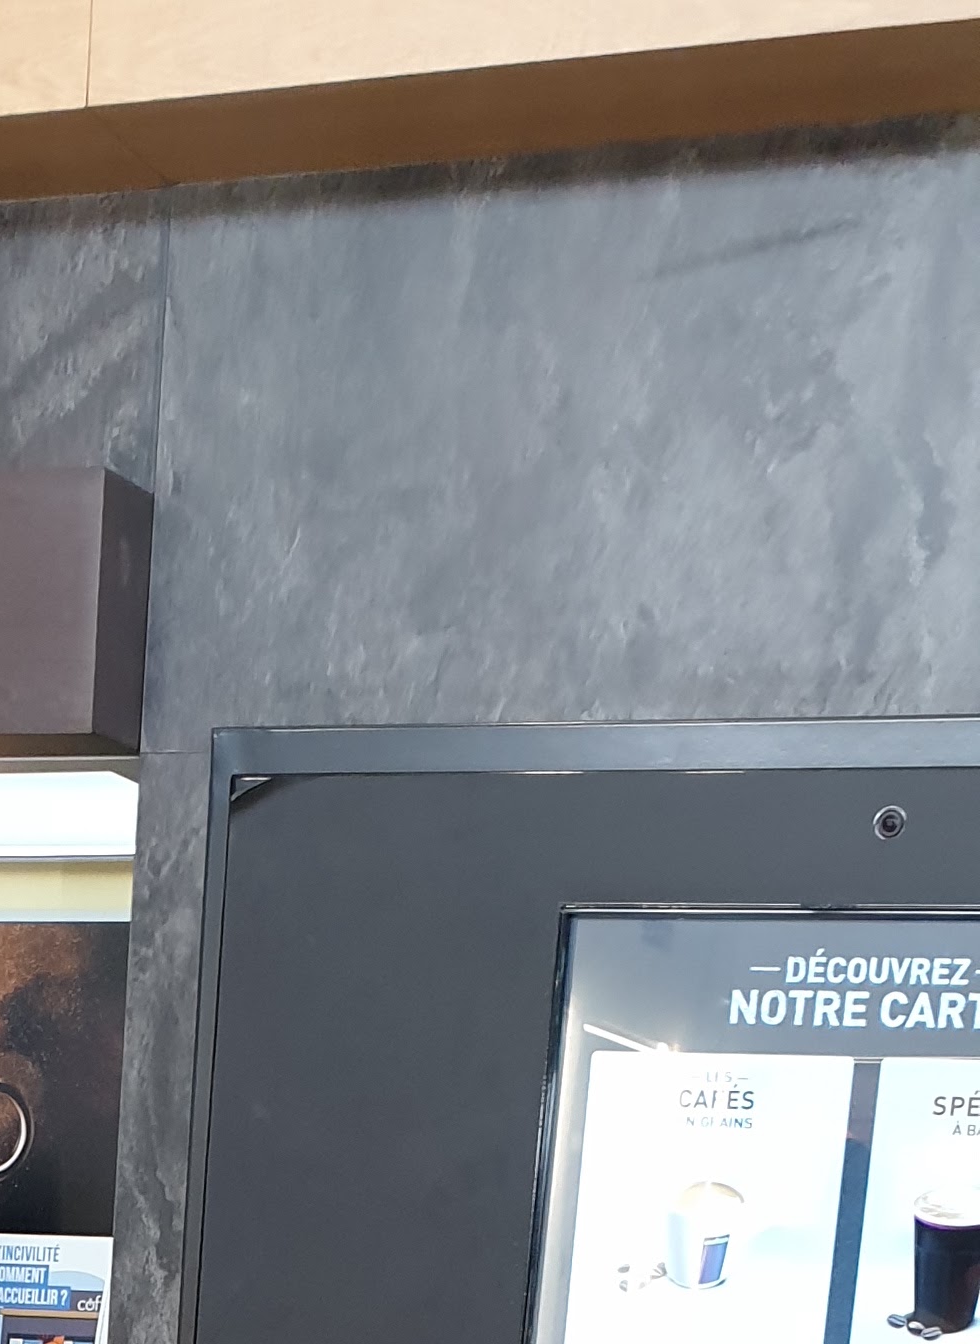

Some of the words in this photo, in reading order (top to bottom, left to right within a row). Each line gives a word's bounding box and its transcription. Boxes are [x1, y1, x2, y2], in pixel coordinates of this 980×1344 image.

[785, 948, 971, 986] DÉCOUVREZ
[729, 989, 871, 1028] NOTRE
[60, 1289, 69, 1307] ?
